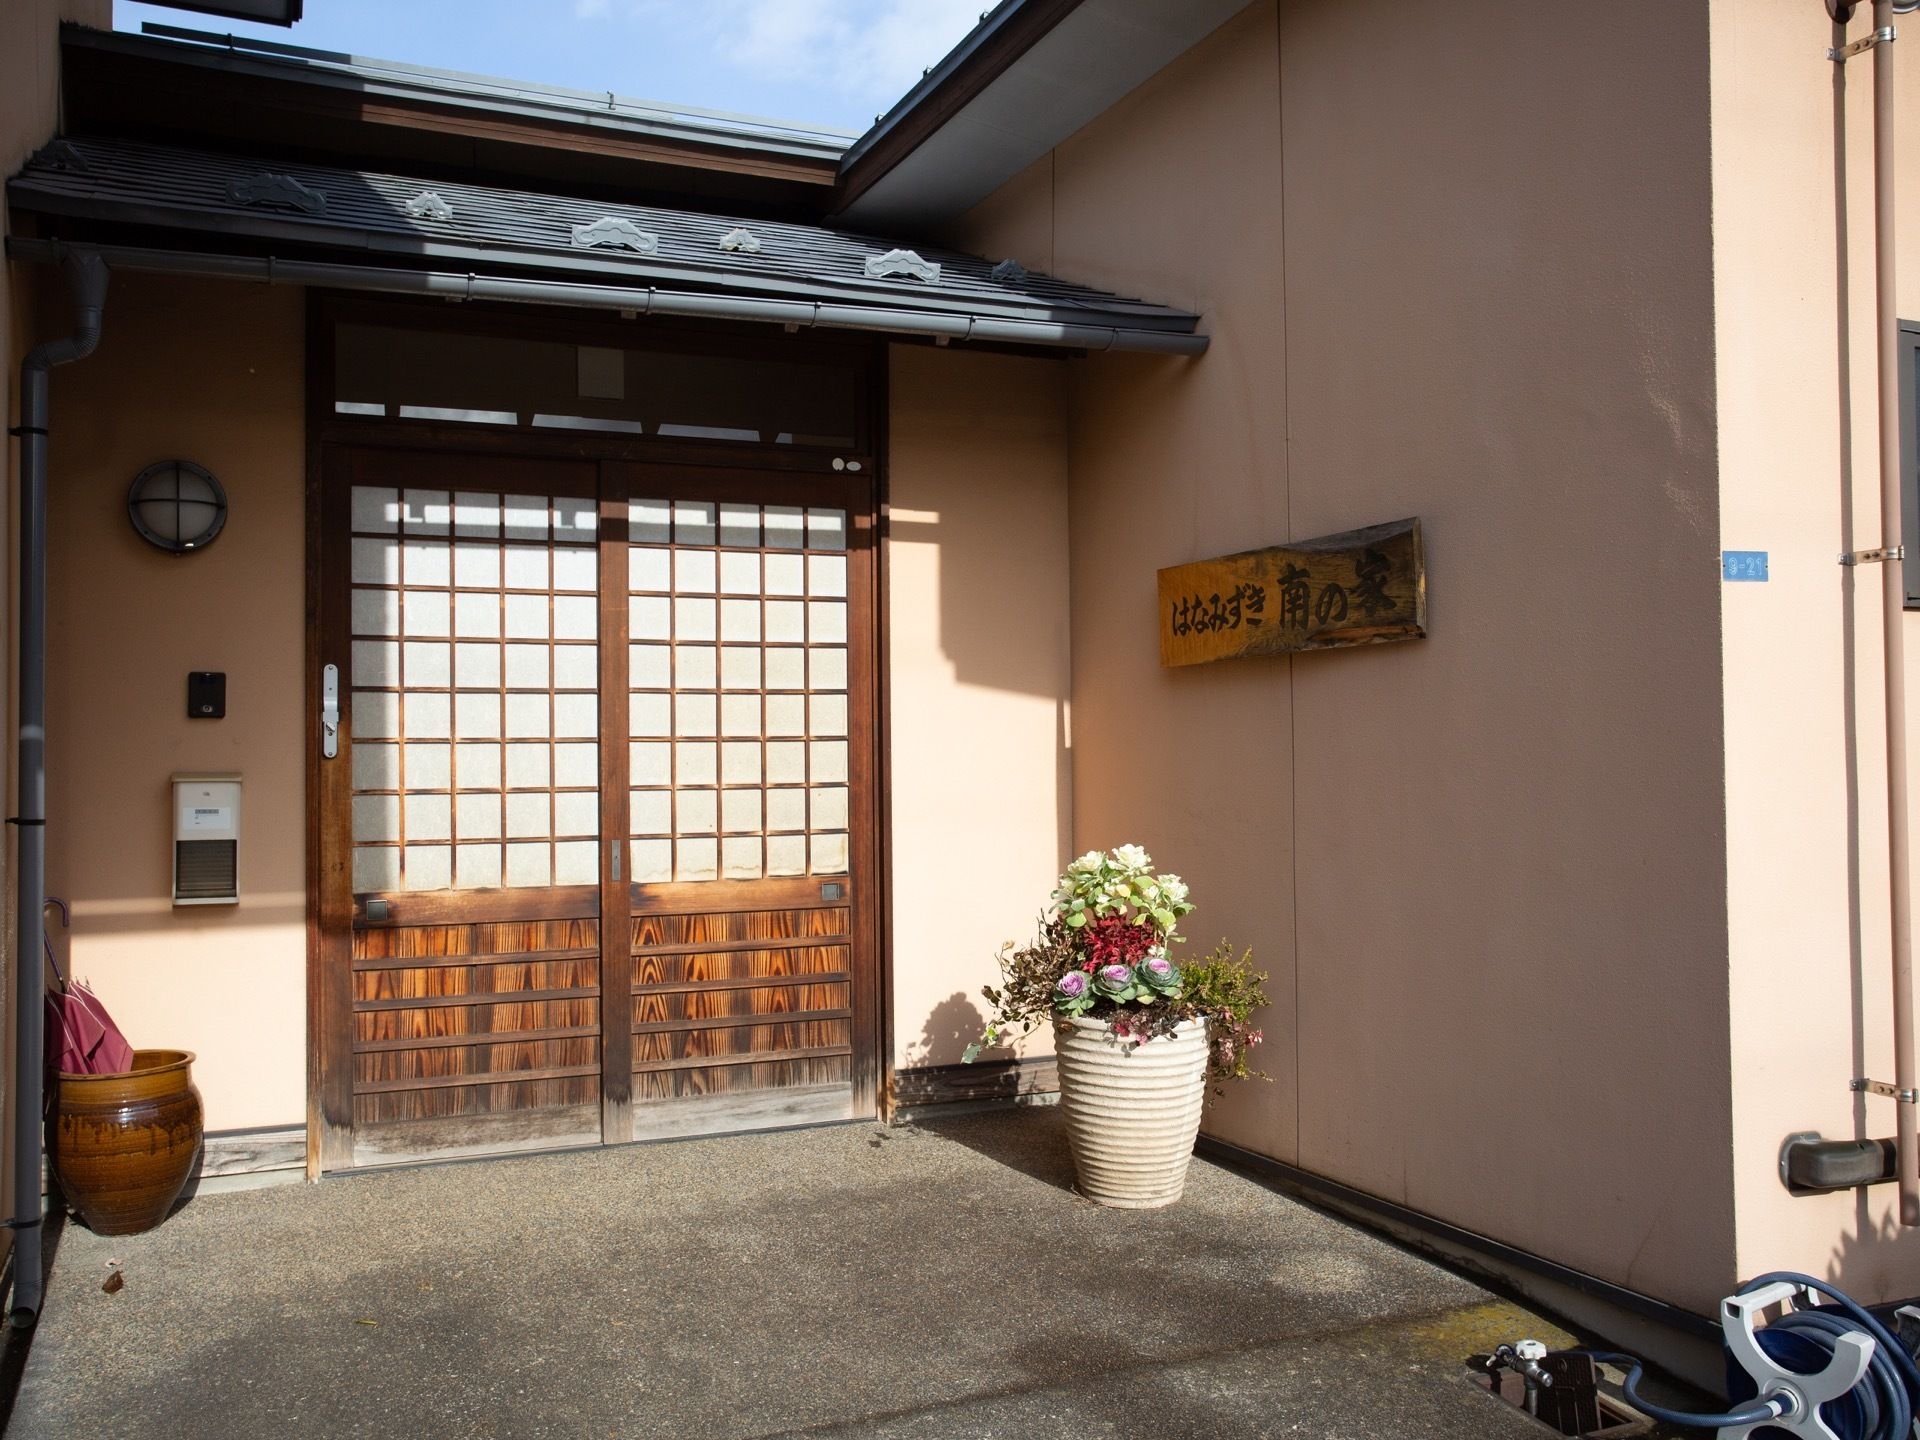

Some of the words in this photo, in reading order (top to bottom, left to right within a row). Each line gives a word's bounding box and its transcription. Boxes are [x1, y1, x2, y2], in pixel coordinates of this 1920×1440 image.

[1172, 583, 1266, 637] はなみずき
